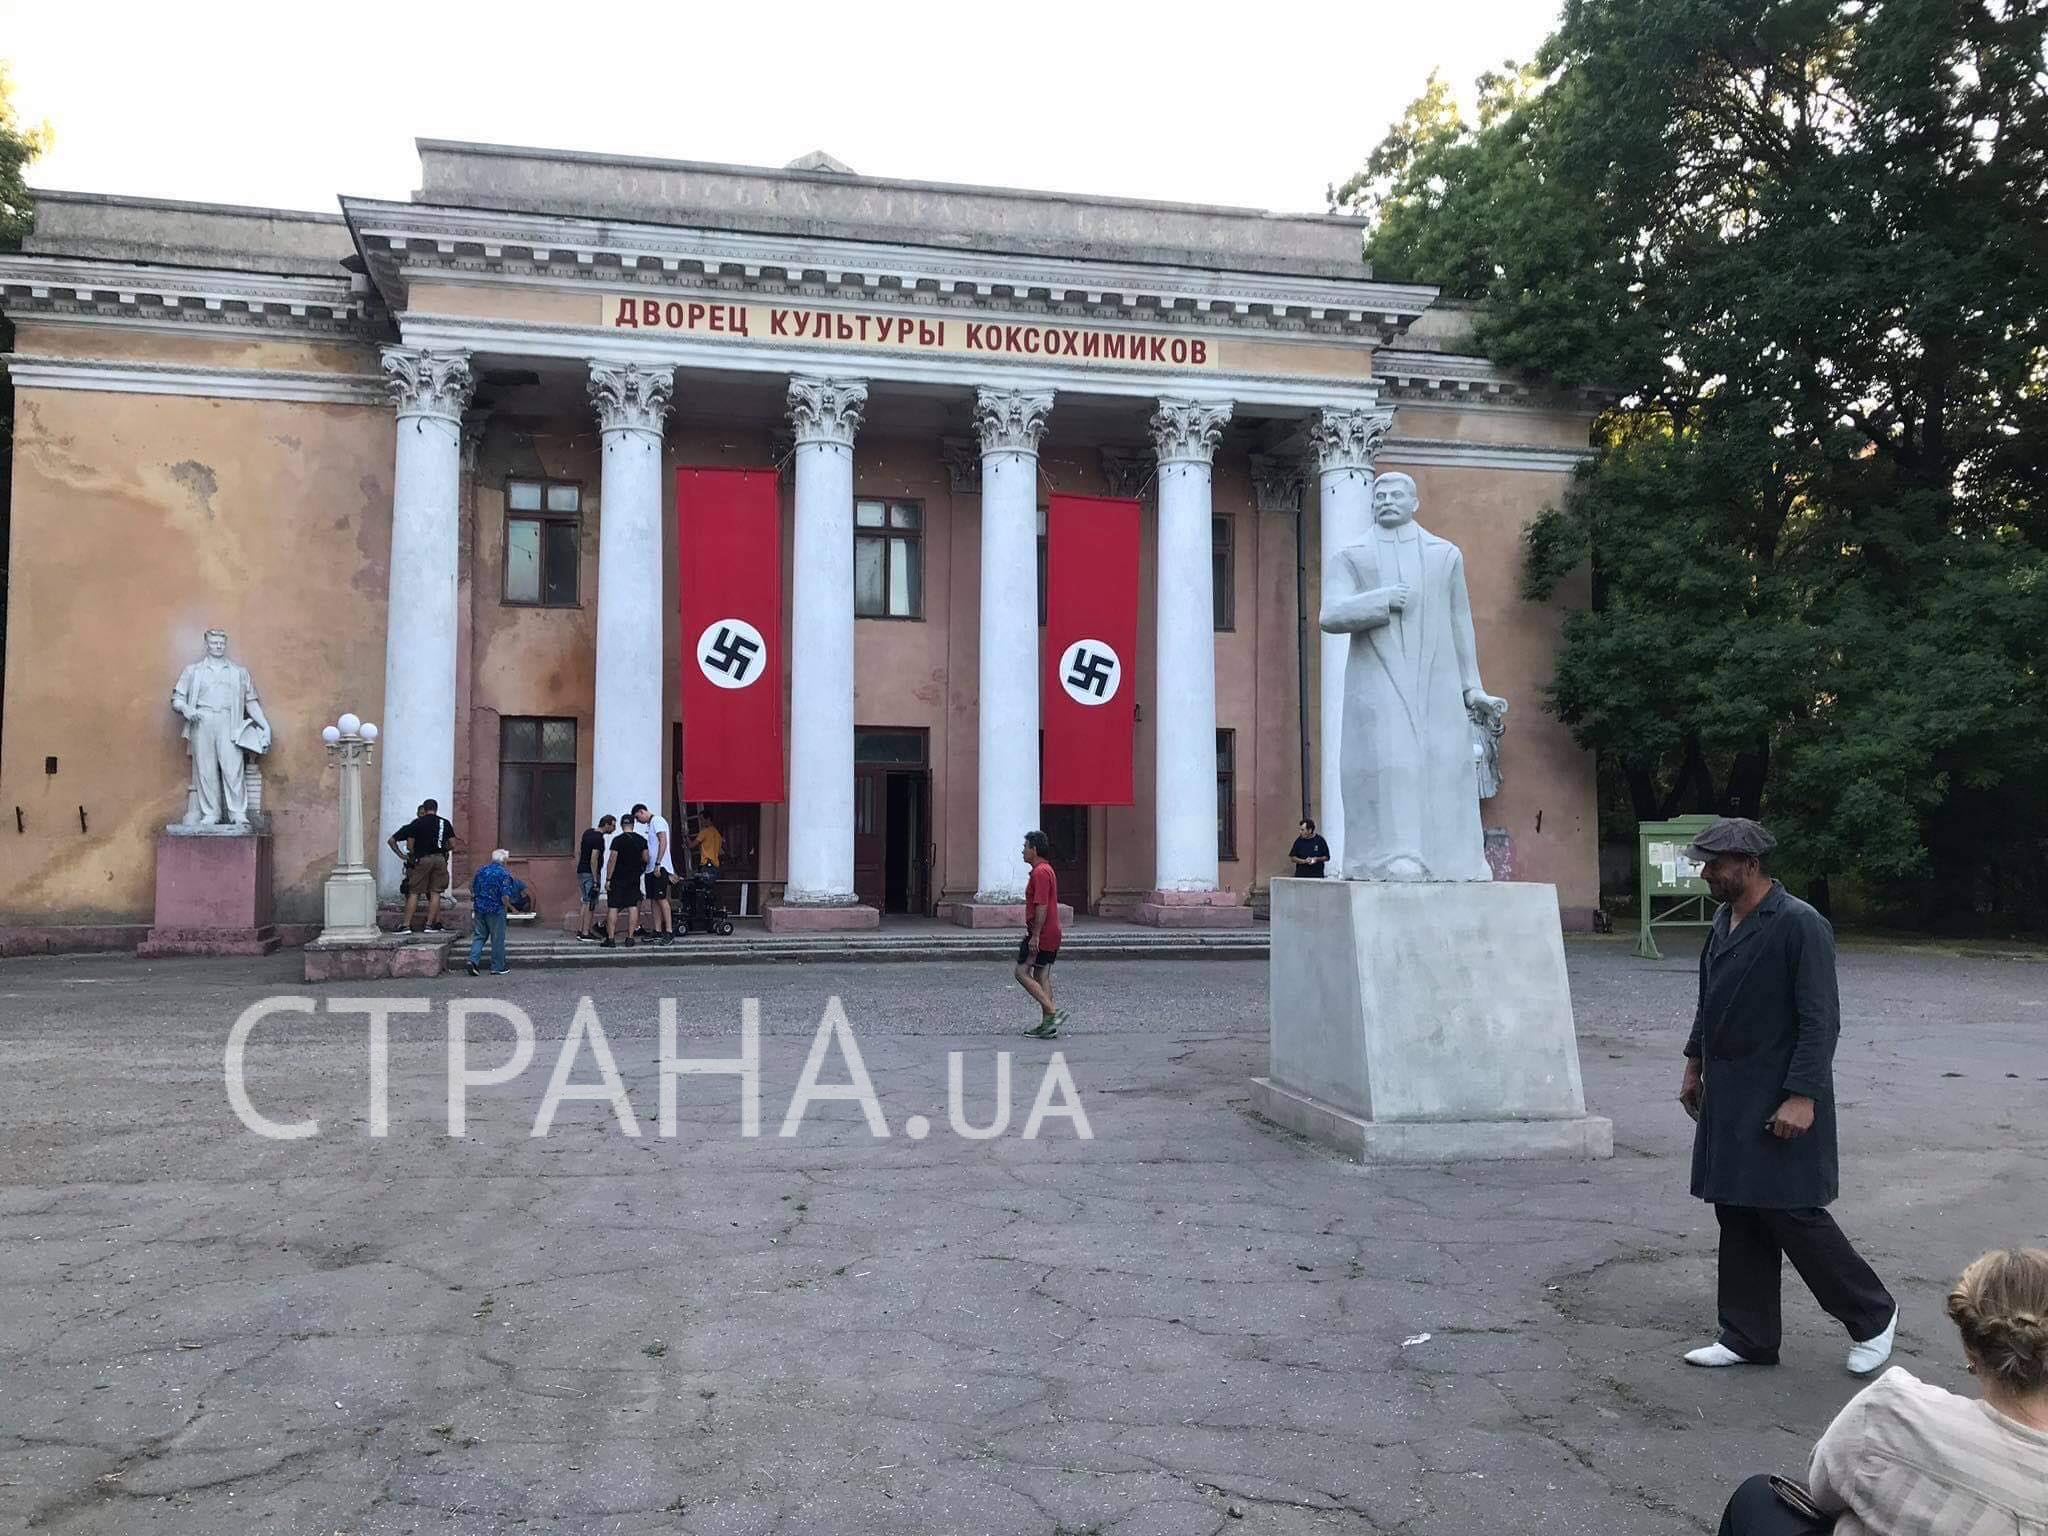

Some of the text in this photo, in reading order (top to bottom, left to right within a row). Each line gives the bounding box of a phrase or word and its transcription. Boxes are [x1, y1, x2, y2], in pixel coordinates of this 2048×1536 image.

[615, 298, 1208, 364] ДВОРЕЦ КУЛЬТУРЫ КОКСОХИМИКОВ
